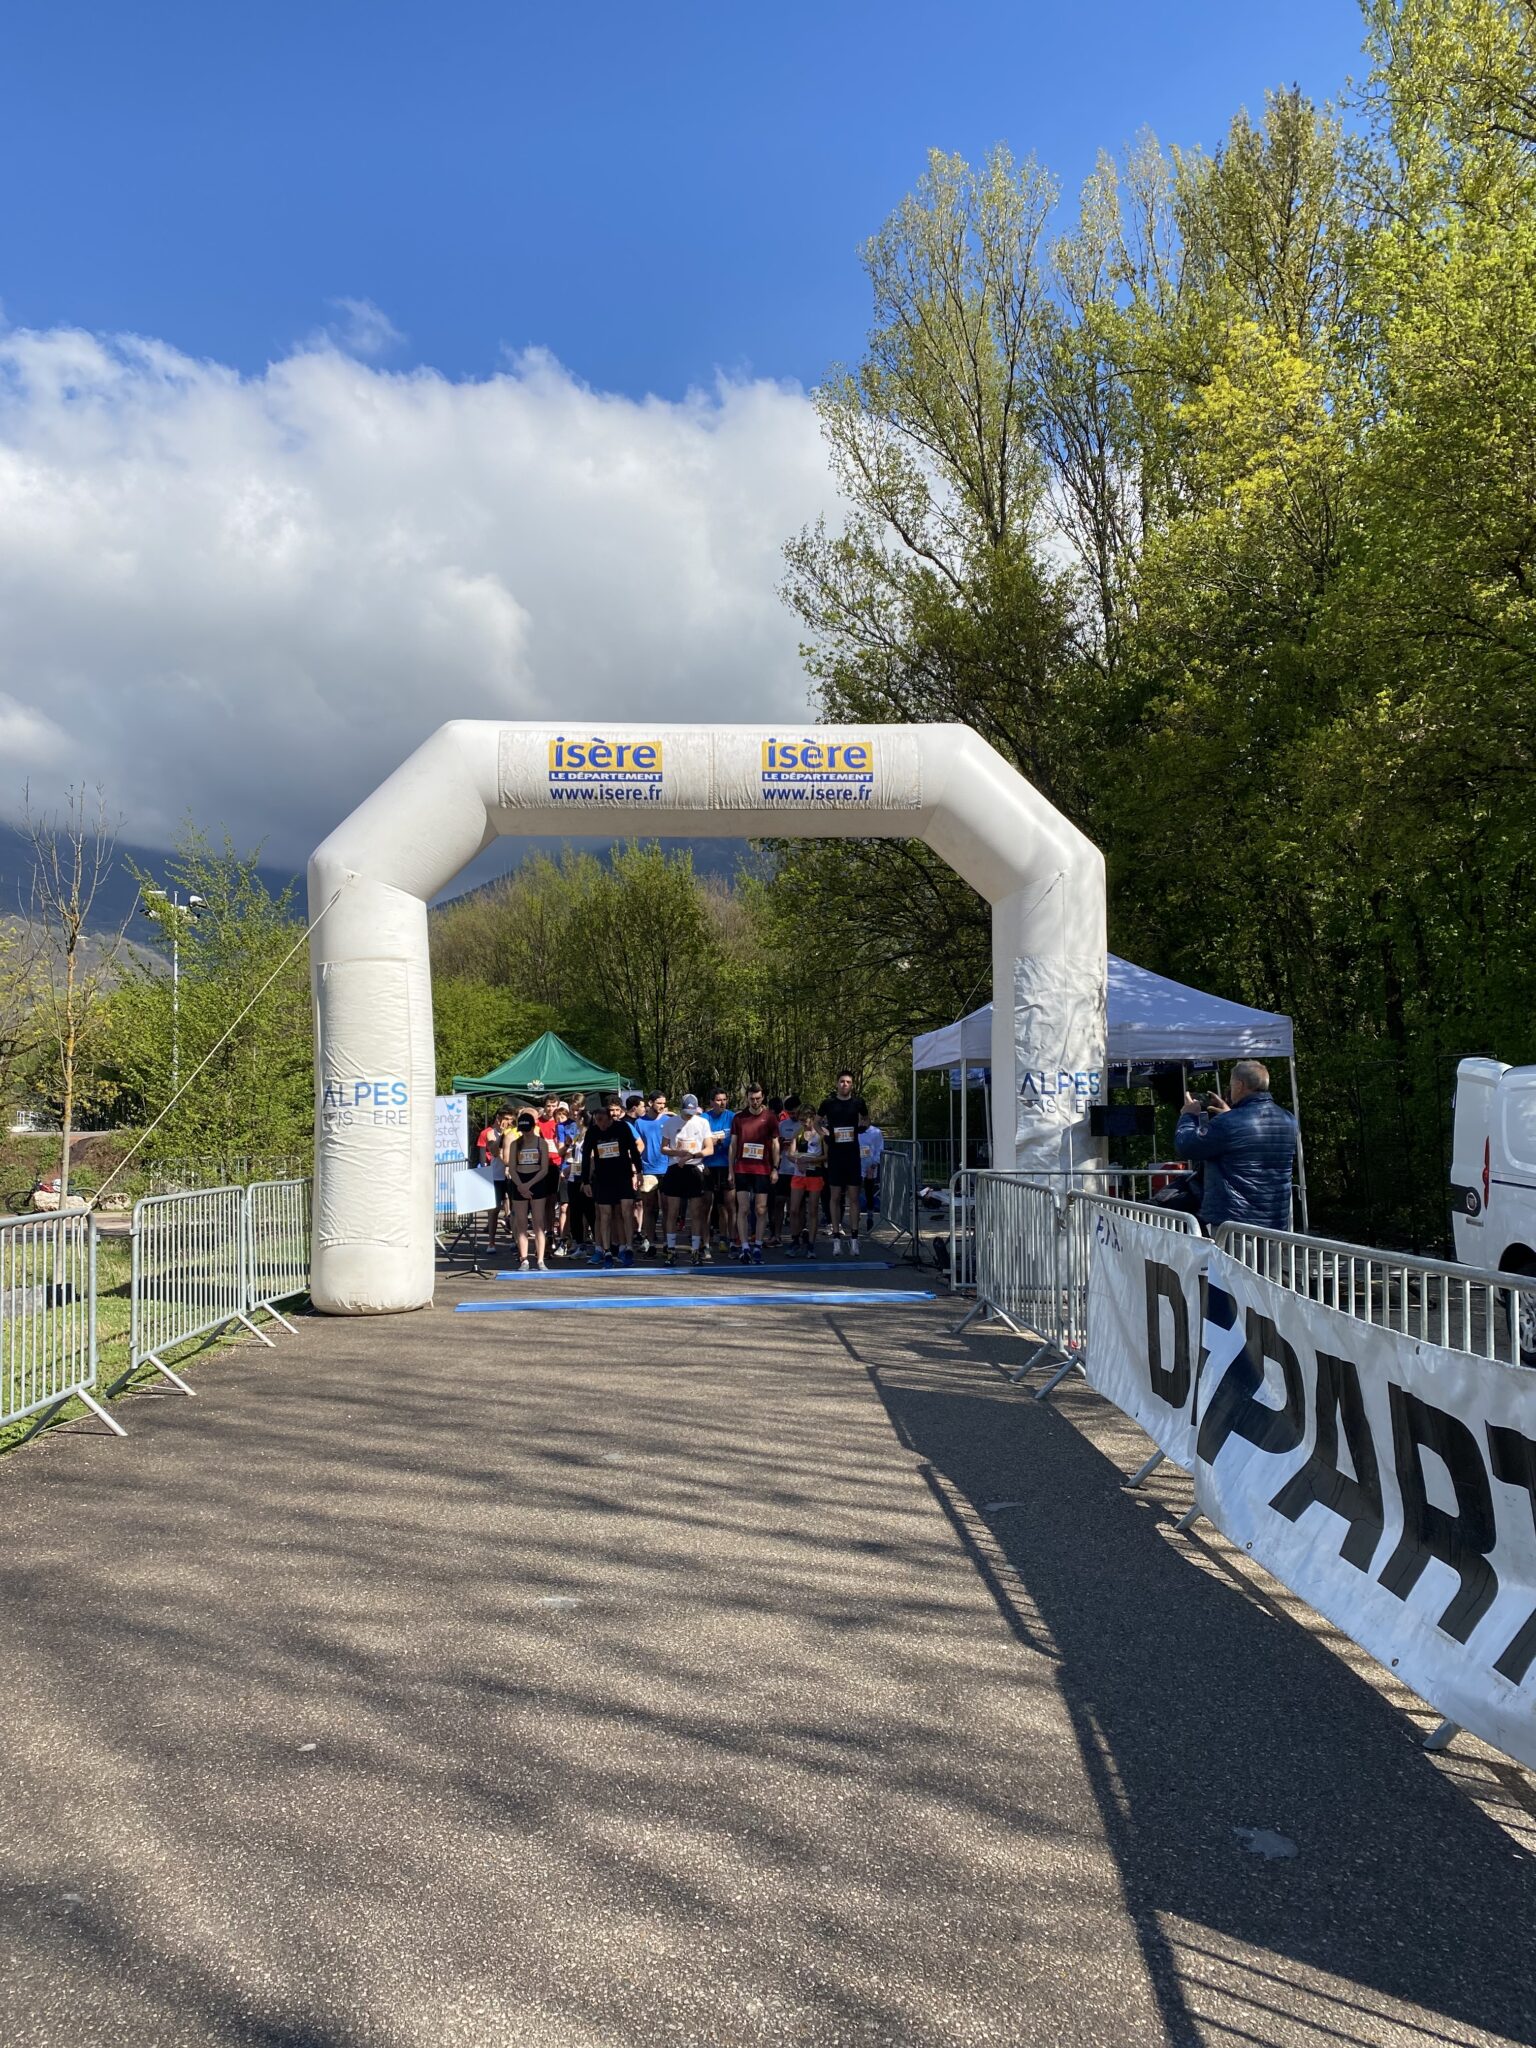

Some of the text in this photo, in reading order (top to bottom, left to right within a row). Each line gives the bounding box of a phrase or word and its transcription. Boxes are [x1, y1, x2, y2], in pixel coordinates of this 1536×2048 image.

[555, 736, 657, 769] isère
[767, 737, 867, 769] isère
[550, 771, 662, 781] LE DÉPARTEMENT
[763, 771, 873, 781] LE DÉPARTEMENT
[549, 784, 662, 801] www.isere.fr
[762, 784, 872, 801] www.isere.fr
[1020, 1072, 1100, 1095] ALPES
[322, 1082, 408, 1108] ALPES
